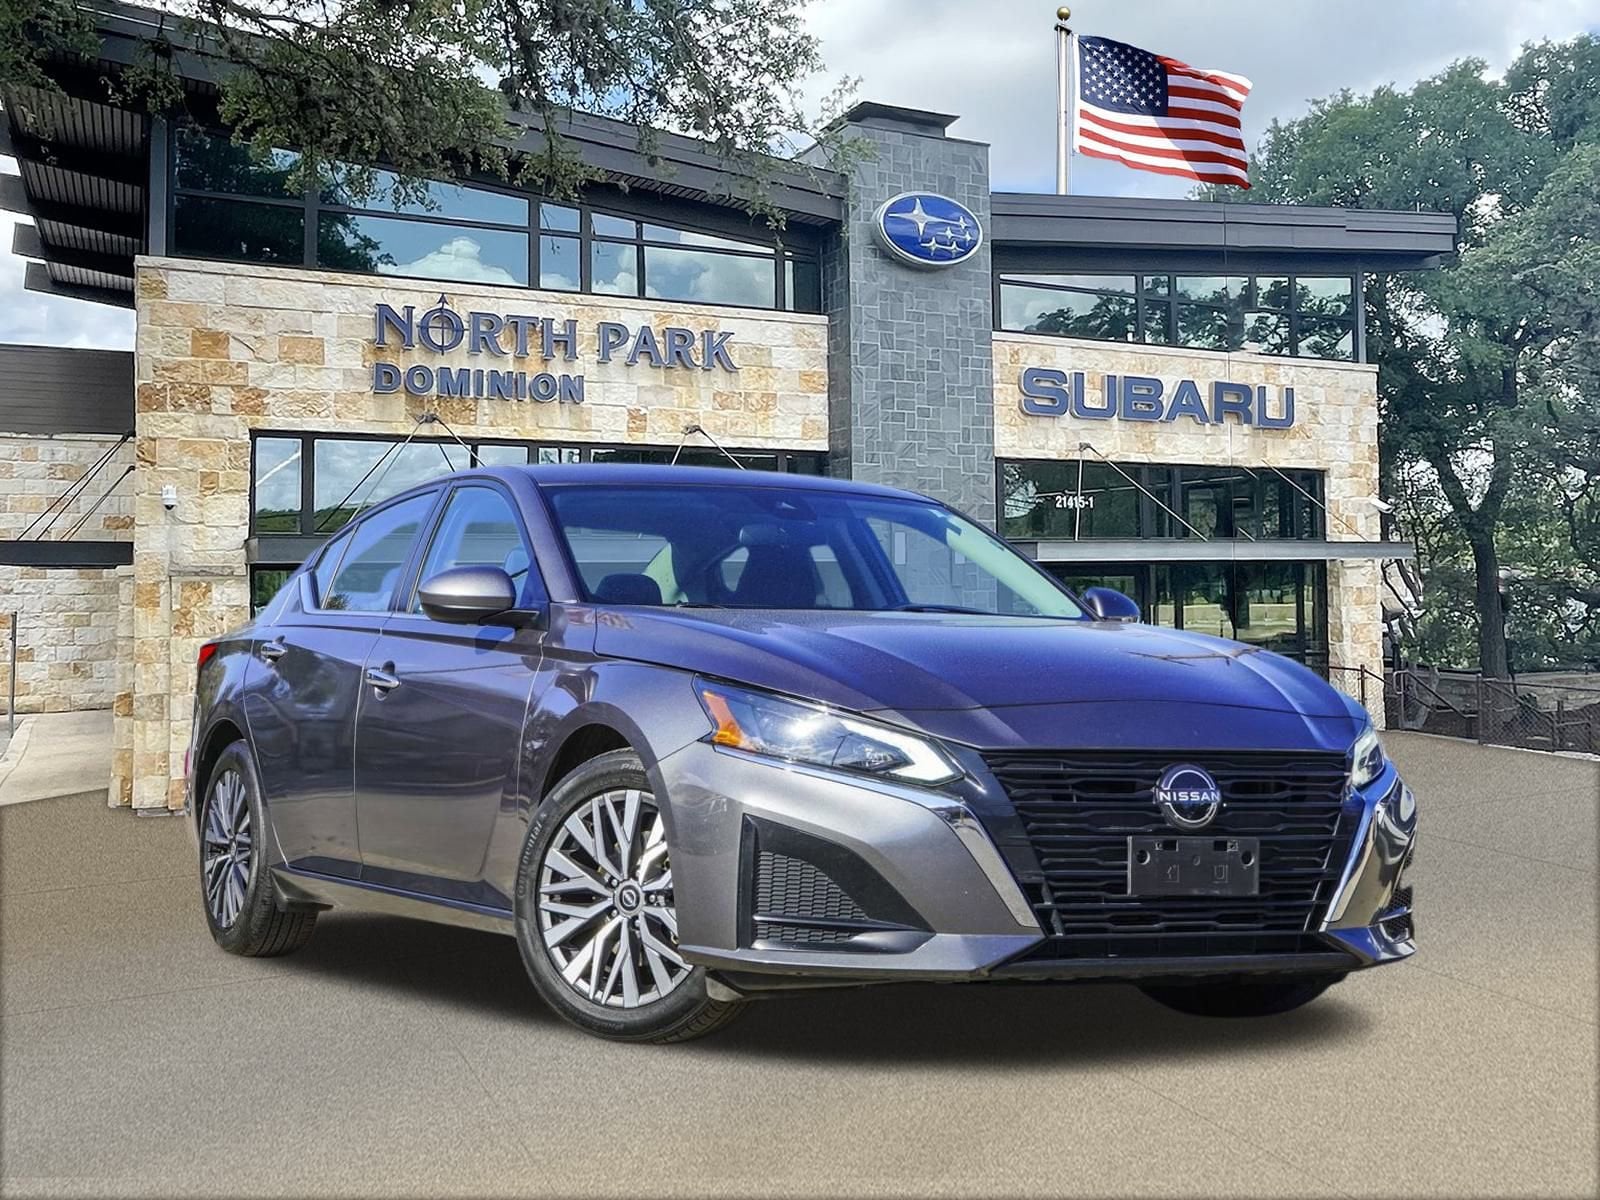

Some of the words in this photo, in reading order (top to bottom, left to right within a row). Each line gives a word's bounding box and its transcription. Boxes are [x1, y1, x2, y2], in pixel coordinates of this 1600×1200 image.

[375, 303, 579, 361] NORTH
[597, 321, 742, 373] PARK
[374, 363, 585, 402] DOMINION
[1018, 367, 1294, 429] SUBARU
[1055, 495, 1094, 508] 21415-1
[1159, 791, 1220, 801] NISSAN
